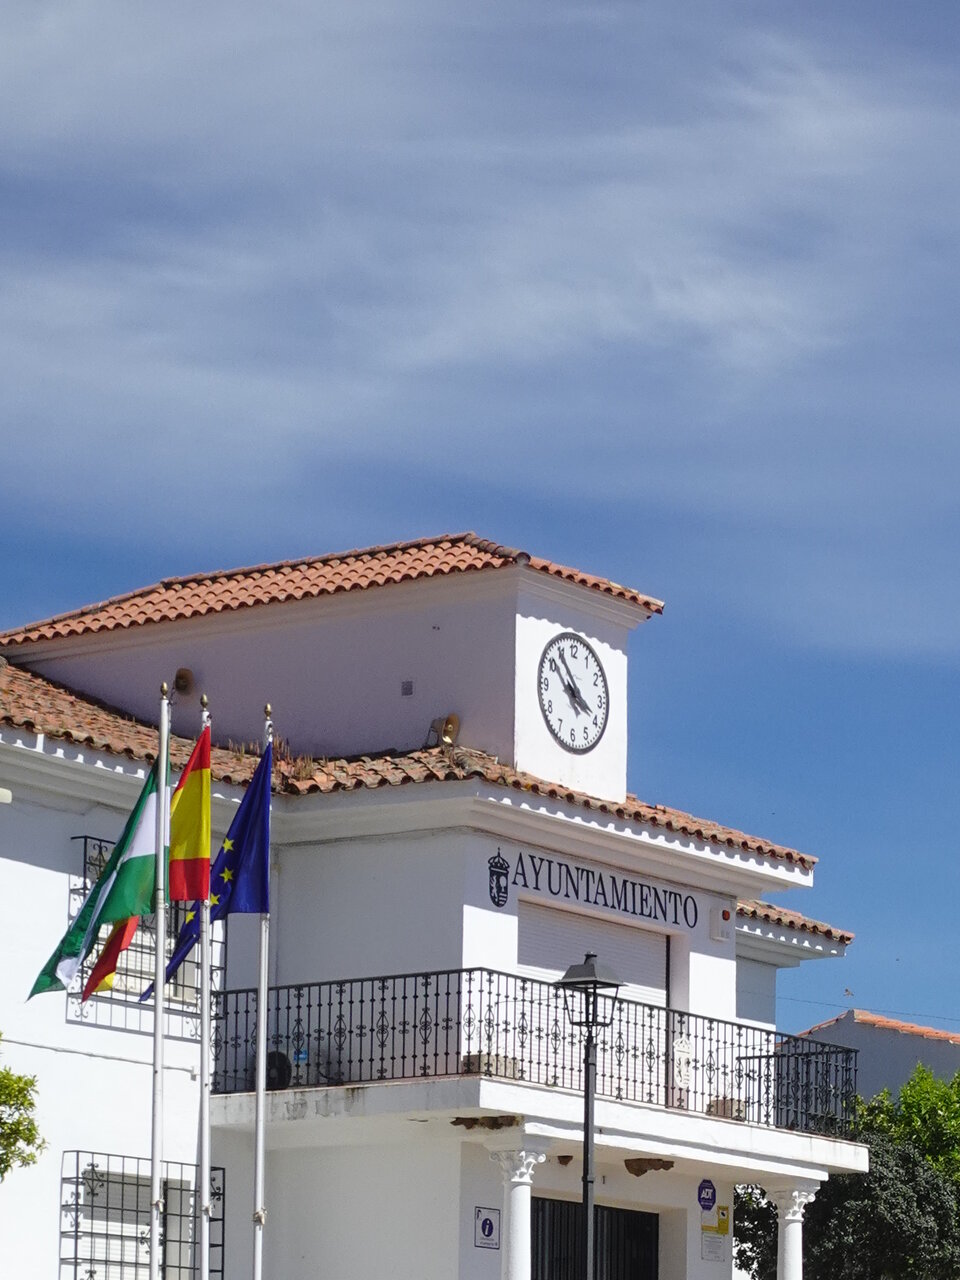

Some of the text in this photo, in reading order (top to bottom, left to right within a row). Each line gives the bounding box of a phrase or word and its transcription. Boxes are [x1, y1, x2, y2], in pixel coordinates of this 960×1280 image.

[570, 644, 578, 659] 12
[585, 655, 589, 669] 1
[543, 677, 549, 691] 9
[593, 672, 599, 687] 2
[547, 700, 553, 714] 8
[597, 695, 603, 709] 3
[558, 718, 563, 732] 7
[592, 714, 598, 728] 4
[570, 728, 576, 742] 6
[583, 726, 589, 741] 5
[511, 852, 698, 929] AYUNTAMIENTO
